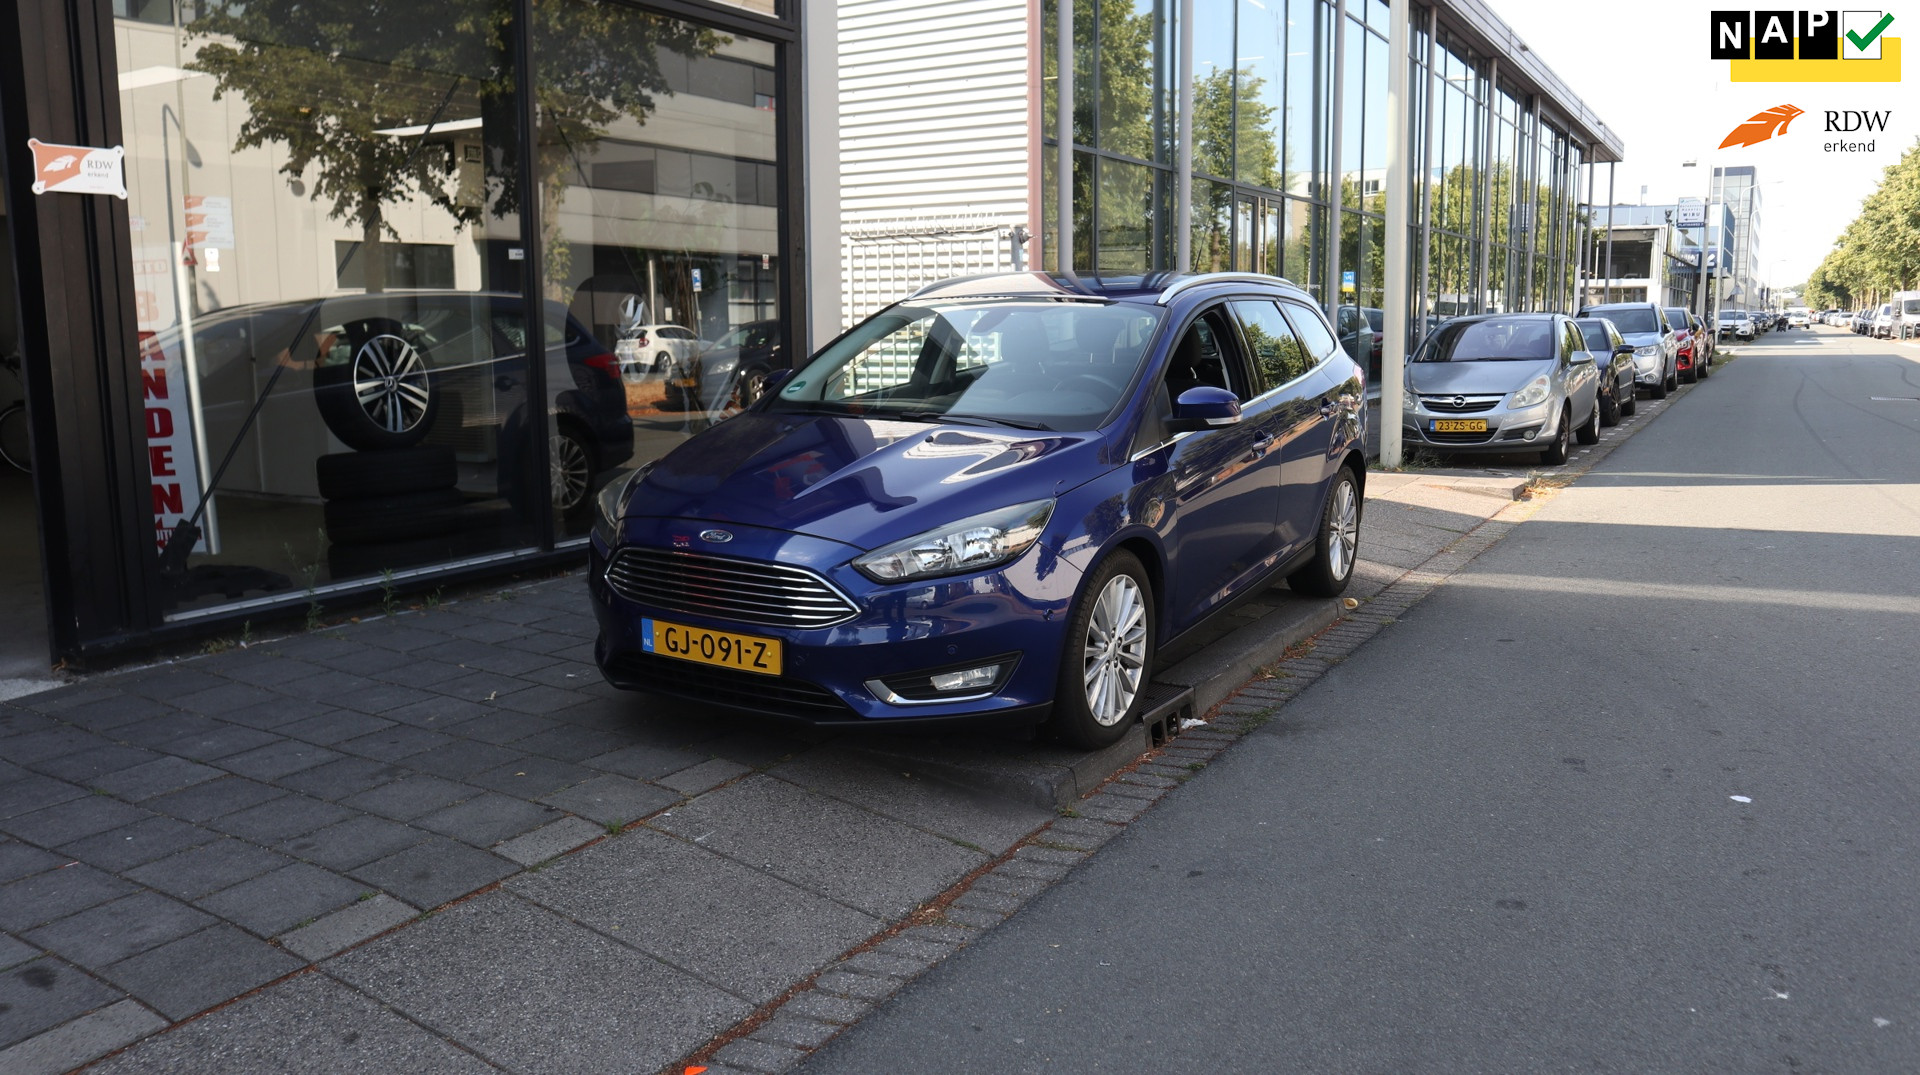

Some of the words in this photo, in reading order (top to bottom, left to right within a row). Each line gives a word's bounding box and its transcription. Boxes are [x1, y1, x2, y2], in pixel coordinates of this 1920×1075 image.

[88, 160, 113, 169] RDW
[1439, 421, 1483, 430] 23-ZS-GG
[643, 638, 653, 647] NL
[665, 627, 768, 669] GJ-091-Z
